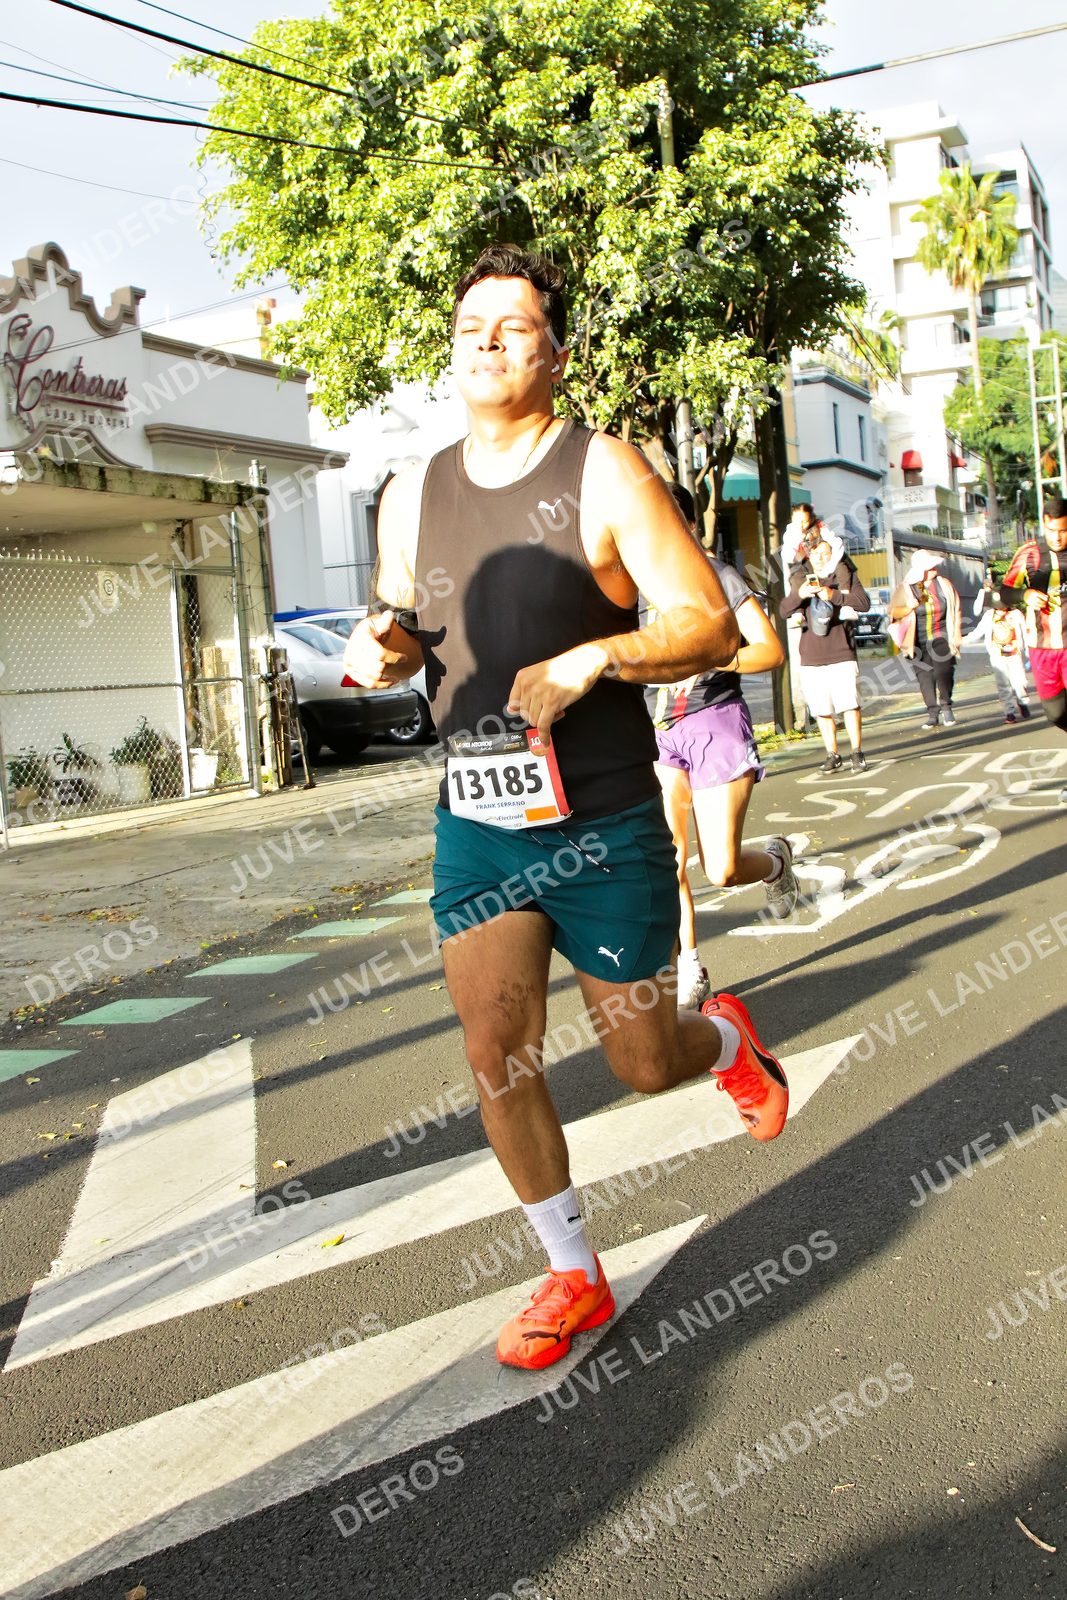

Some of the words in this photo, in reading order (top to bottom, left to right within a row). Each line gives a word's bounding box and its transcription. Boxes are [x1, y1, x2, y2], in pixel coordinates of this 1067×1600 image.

[451, 762, 543, 801] 13185
[475, 802, 497, 810] FRANK
[498, 800, 526, 809] SERRANO
